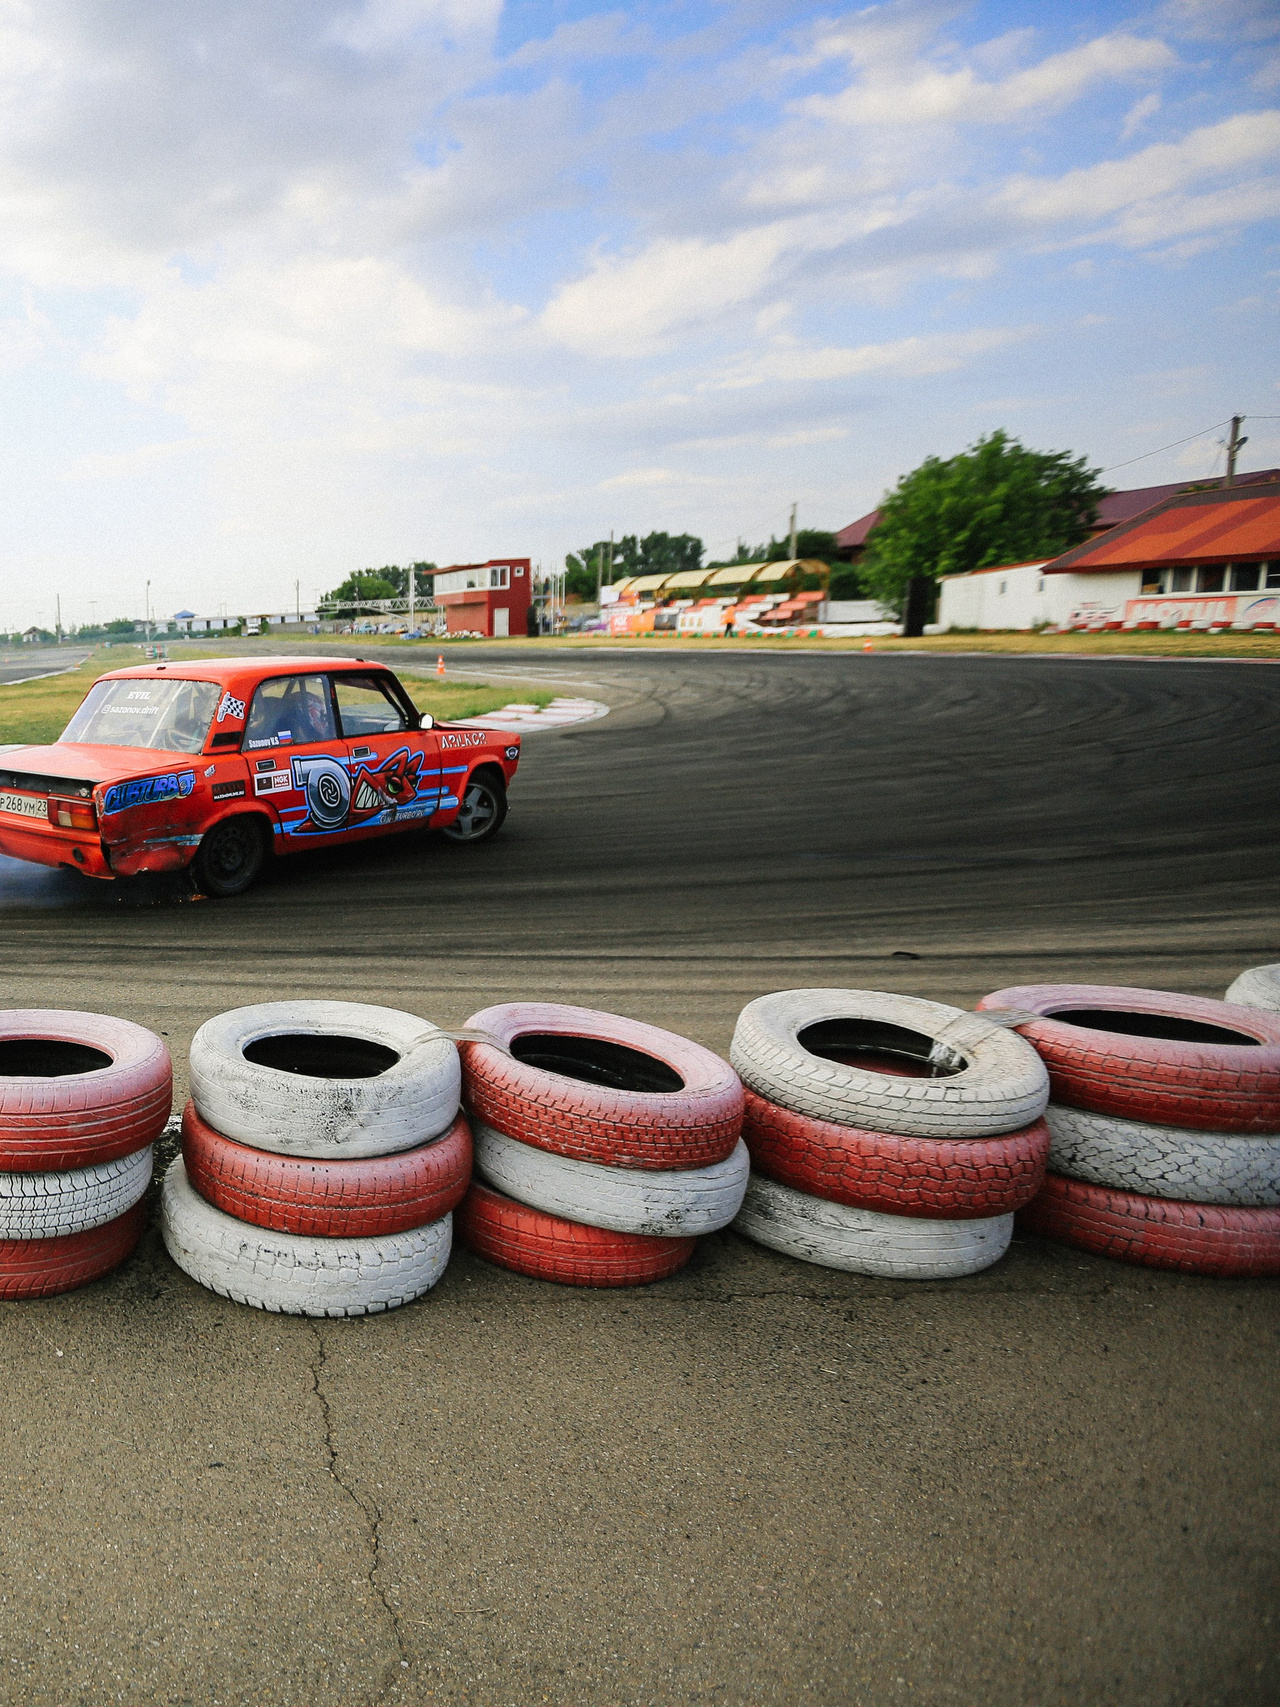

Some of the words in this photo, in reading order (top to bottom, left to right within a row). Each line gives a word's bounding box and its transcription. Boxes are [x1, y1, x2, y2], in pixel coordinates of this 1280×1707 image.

[1132, 602, 1227, 621] MOTUL
[127, 691, 151, 699] EVIL
[110, 706, 159, 714] sazonov.drift
[274, 775, 288, 784] NGK
[37, 801, 47, 812] 23
